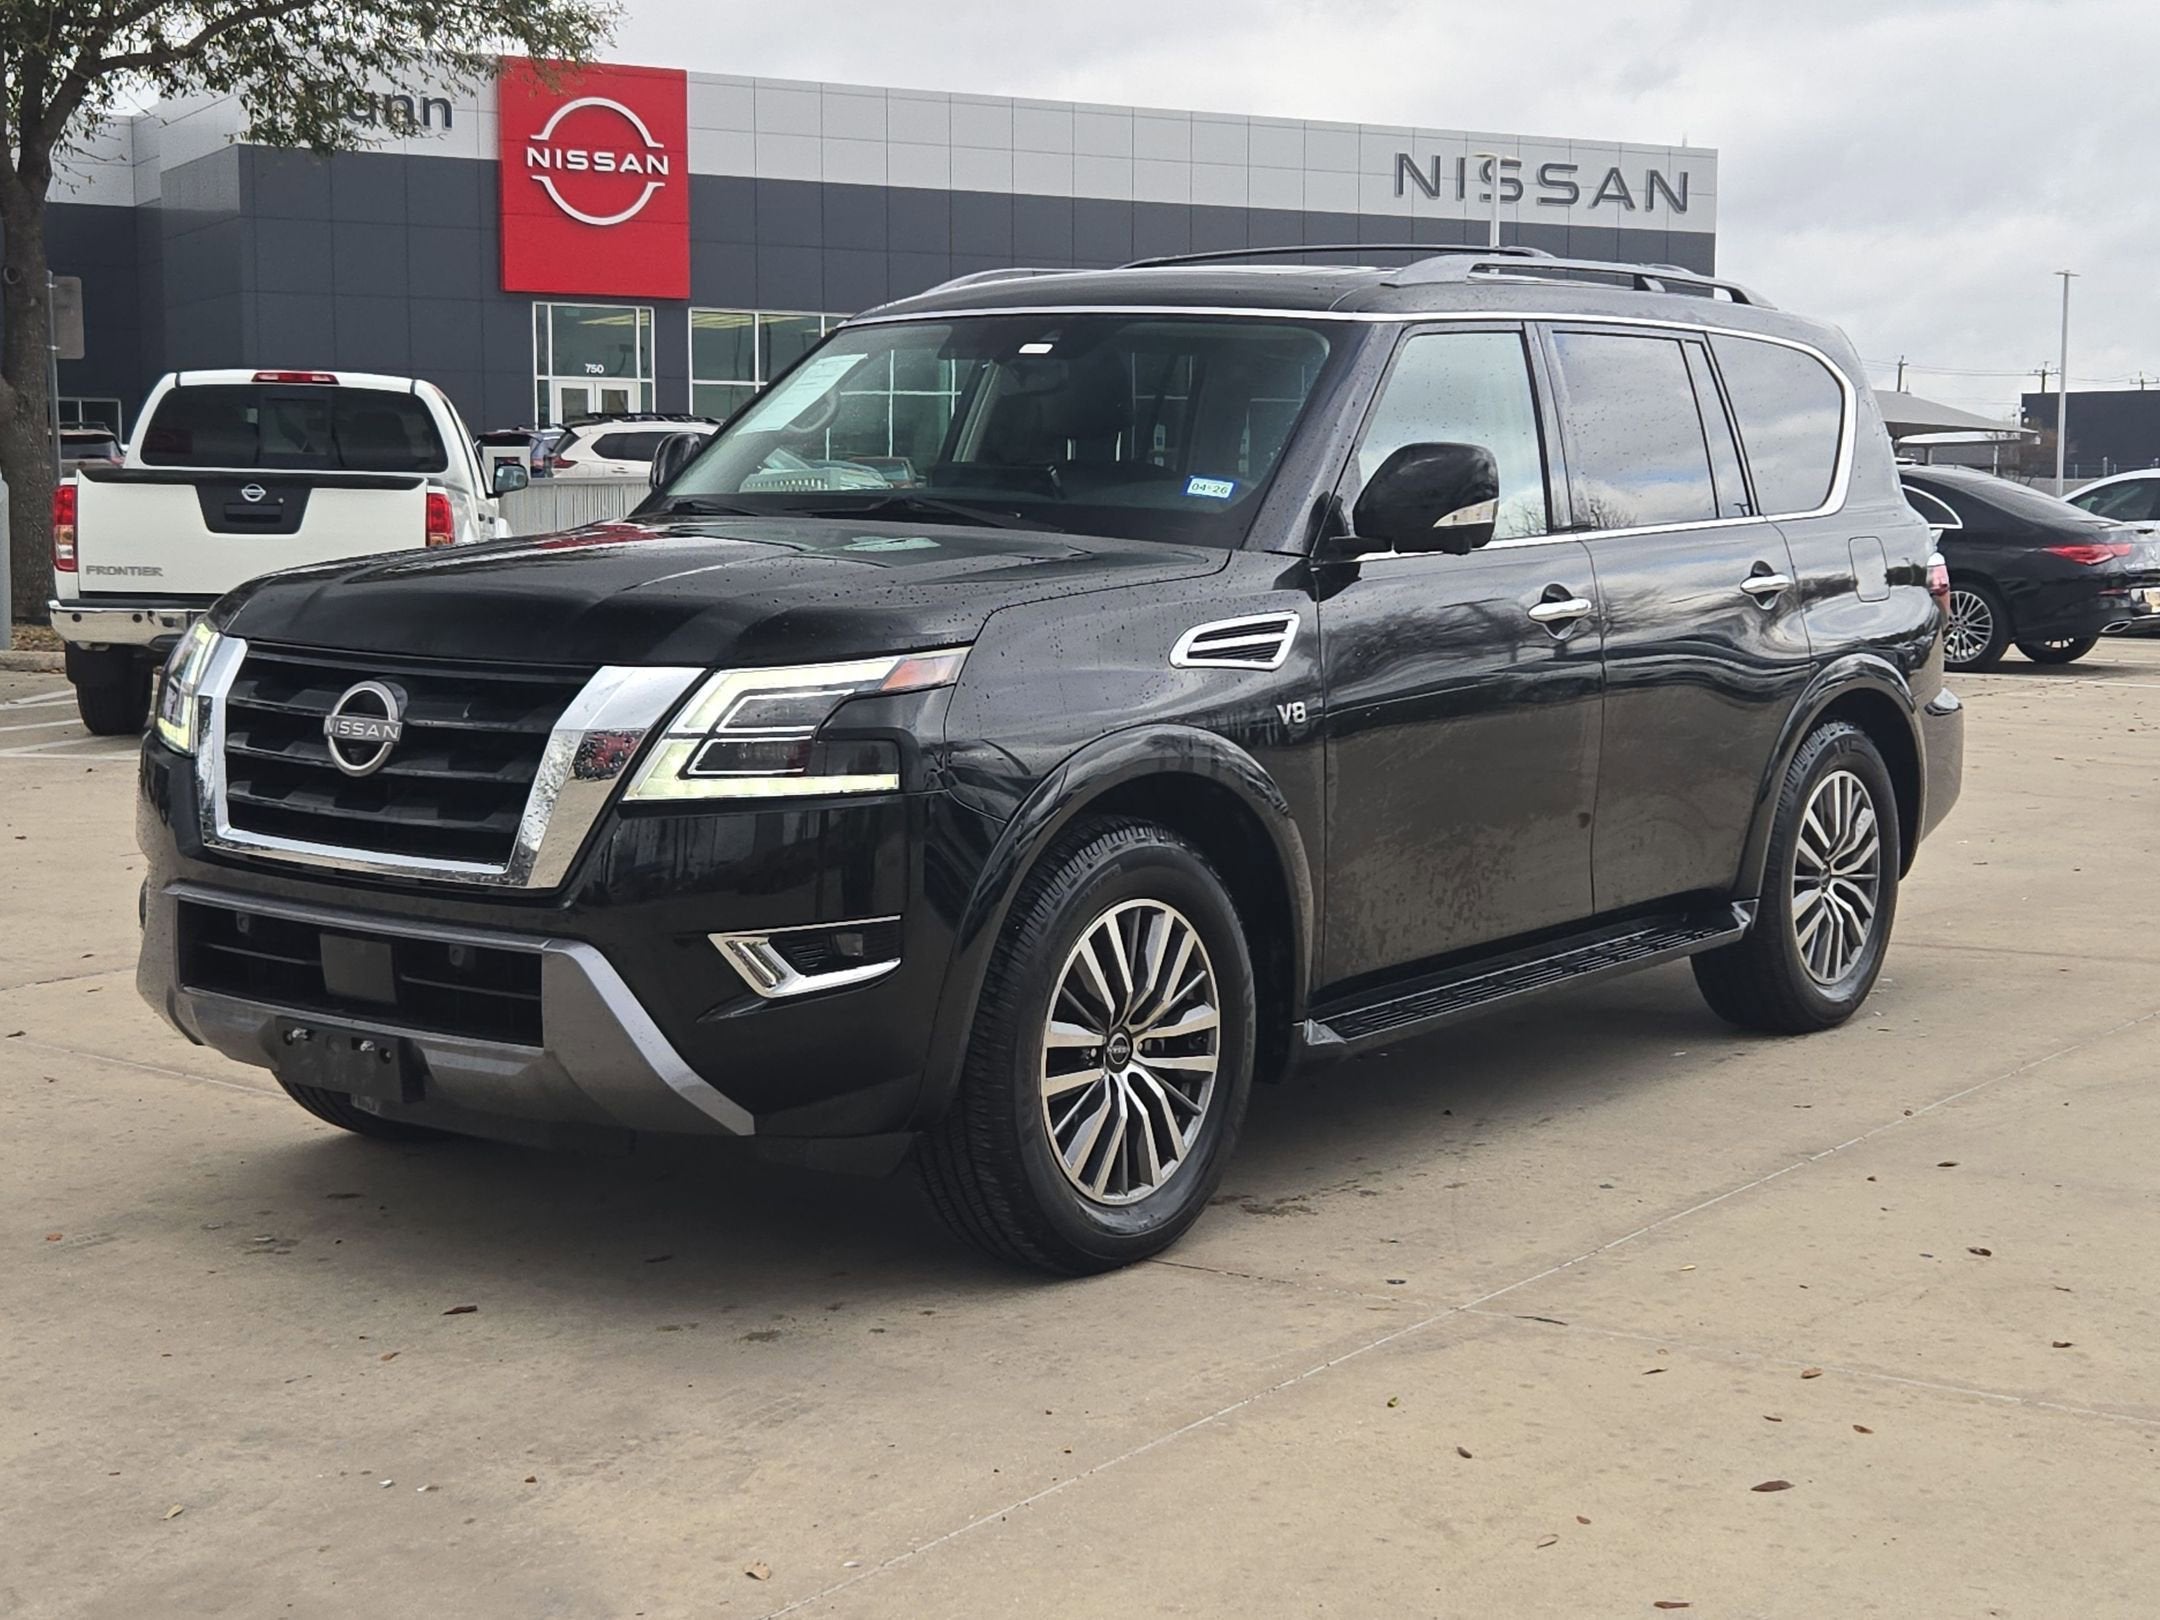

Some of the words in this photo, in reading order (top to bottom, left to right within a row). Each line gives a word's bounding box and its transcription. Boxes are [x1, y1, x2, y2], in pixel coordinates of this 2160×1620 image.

[340, 93, 453, 130] unn
[527, 147, 669, 176] NISSAN
[1395, 152, 1689, 214] NISSAN
[585, 363, 604, 374] 750
[86, 565, 163, 577] FRONTIER
[1276, 701, 1306, 725] V8
[324, 716, 400, 739] NISSAN
